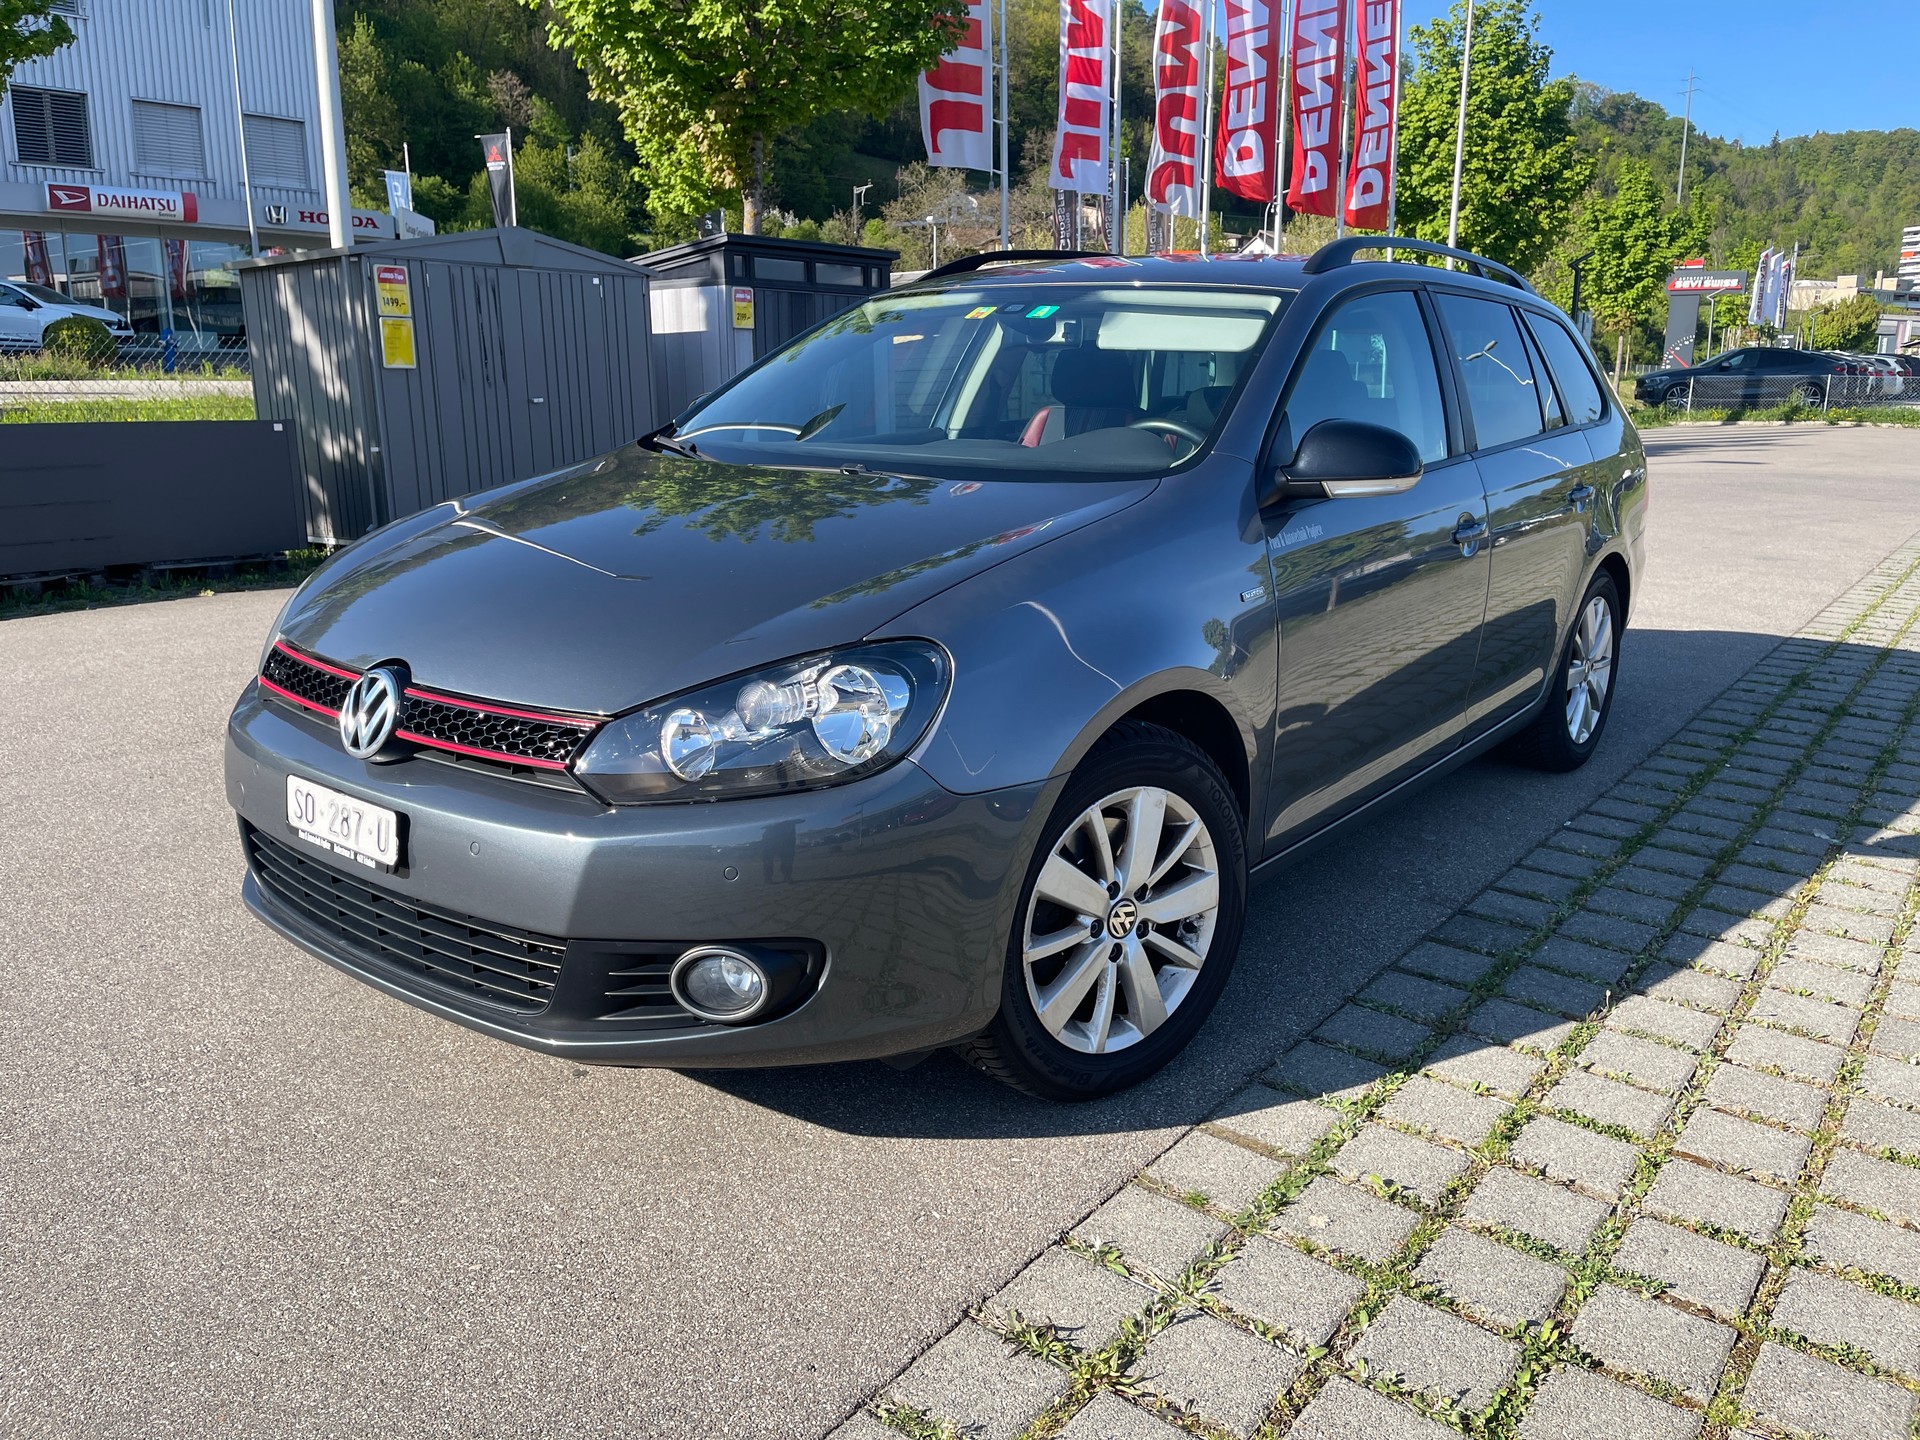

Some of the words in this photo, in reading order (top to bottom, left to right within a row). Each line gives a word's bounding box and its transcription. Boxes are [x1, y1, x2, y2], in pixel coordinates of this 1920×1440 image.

[97, 193, 178, 212] DAIHATSU
[298, 210, 380, 229] HODA
[1703, 278, 1739, 288] SWISS
[294, 788, 315, 826] SO
[328, 801, 364, 847] 287
[376, 817, 391, 854] U
[1207, 780, 1244, 865] YOKOHAMA
